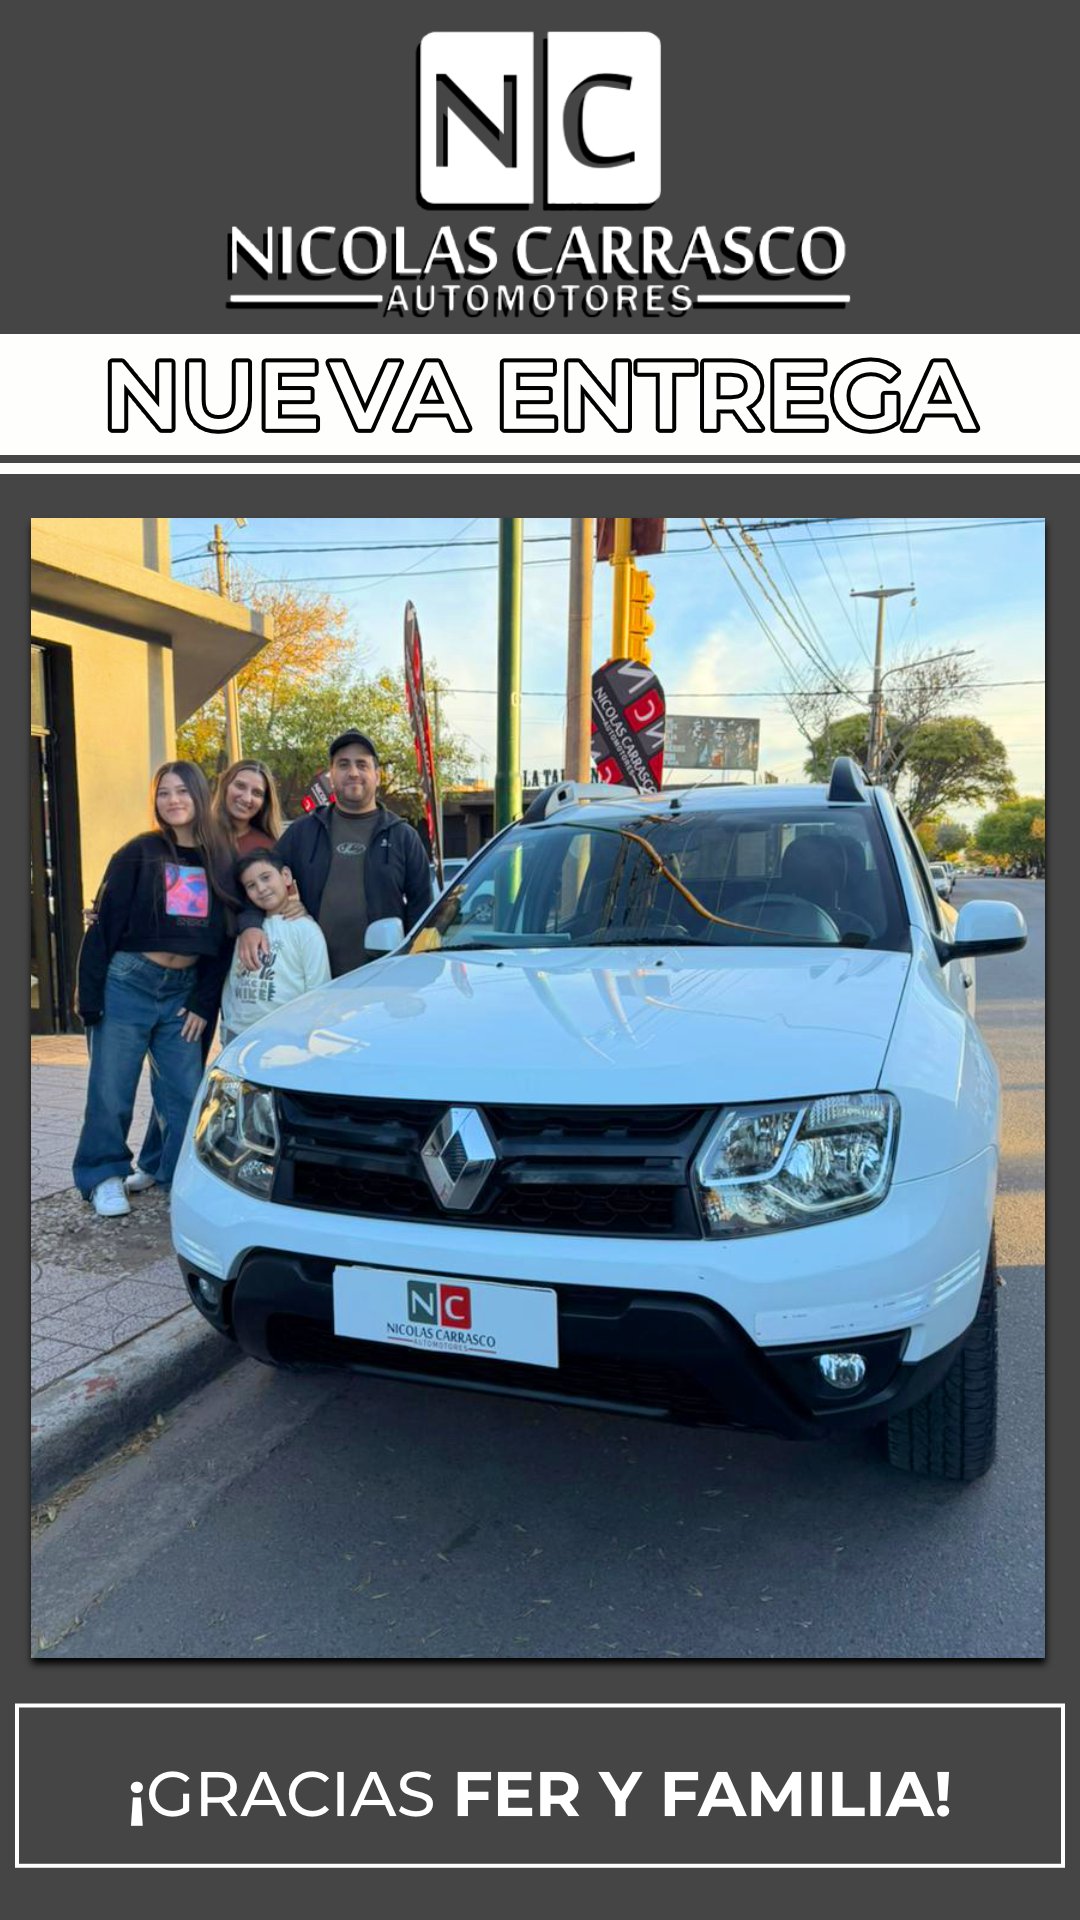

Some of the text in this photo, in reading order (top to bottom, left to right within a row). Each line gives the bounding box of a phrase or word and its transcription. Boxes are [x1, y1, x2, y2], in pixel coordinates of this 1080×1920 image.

[594, 686, 628, 742] NICOLAS
[387, 1322, 496, 1348] NICOLAS CARRASCO
[413, 1338, 468, 1352] AUTOMOTORES
